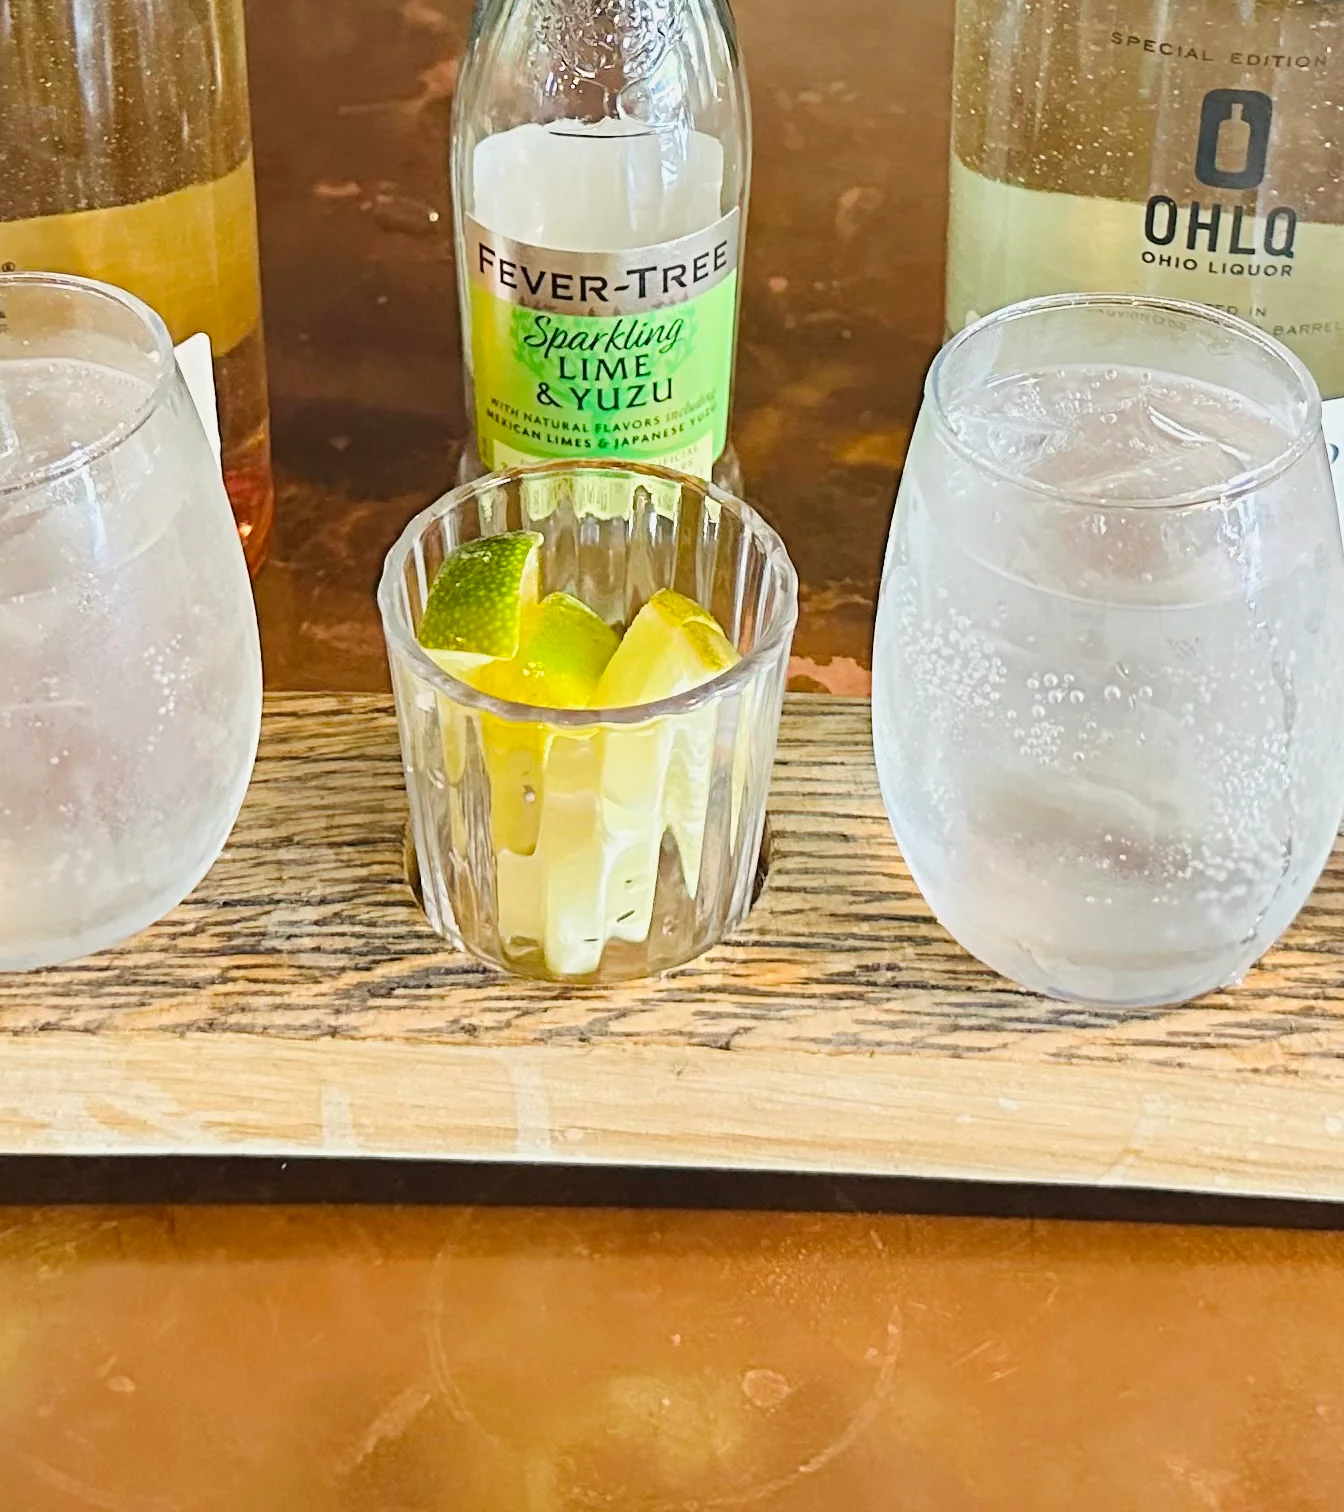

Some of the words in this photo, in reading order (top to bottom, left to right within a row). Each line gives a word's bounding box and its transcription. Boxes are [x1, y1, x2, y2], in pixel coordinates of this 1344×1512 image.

[1110, 31, 1214, 62] SPECIAL
[1229, 51, 1328, 69] EDITION
[1143, 194, 1299, 260] OHLQ
[478, 240, 728, 303] FEVER-TREE
[1141, 251, 1198, 271] OHIO
[1208, 261, 1294, 278] LIQUOR
[523, 314, 684, 359] Sparkling
[558, 353, 652, 381] LIME
[536, 381, 562, 409] &
[569, 377, 673, 411] YUZU
[485, 407, 542, 441] MEXICAN
[546, 432, 592, 449] LIMES
[613, 422, 685, 450] JAPANESE
[490, 396, 520, 418] WITH
[522, 411, 590, 434] NATURAL
[593, 415, 661, 434] FLAVORS
